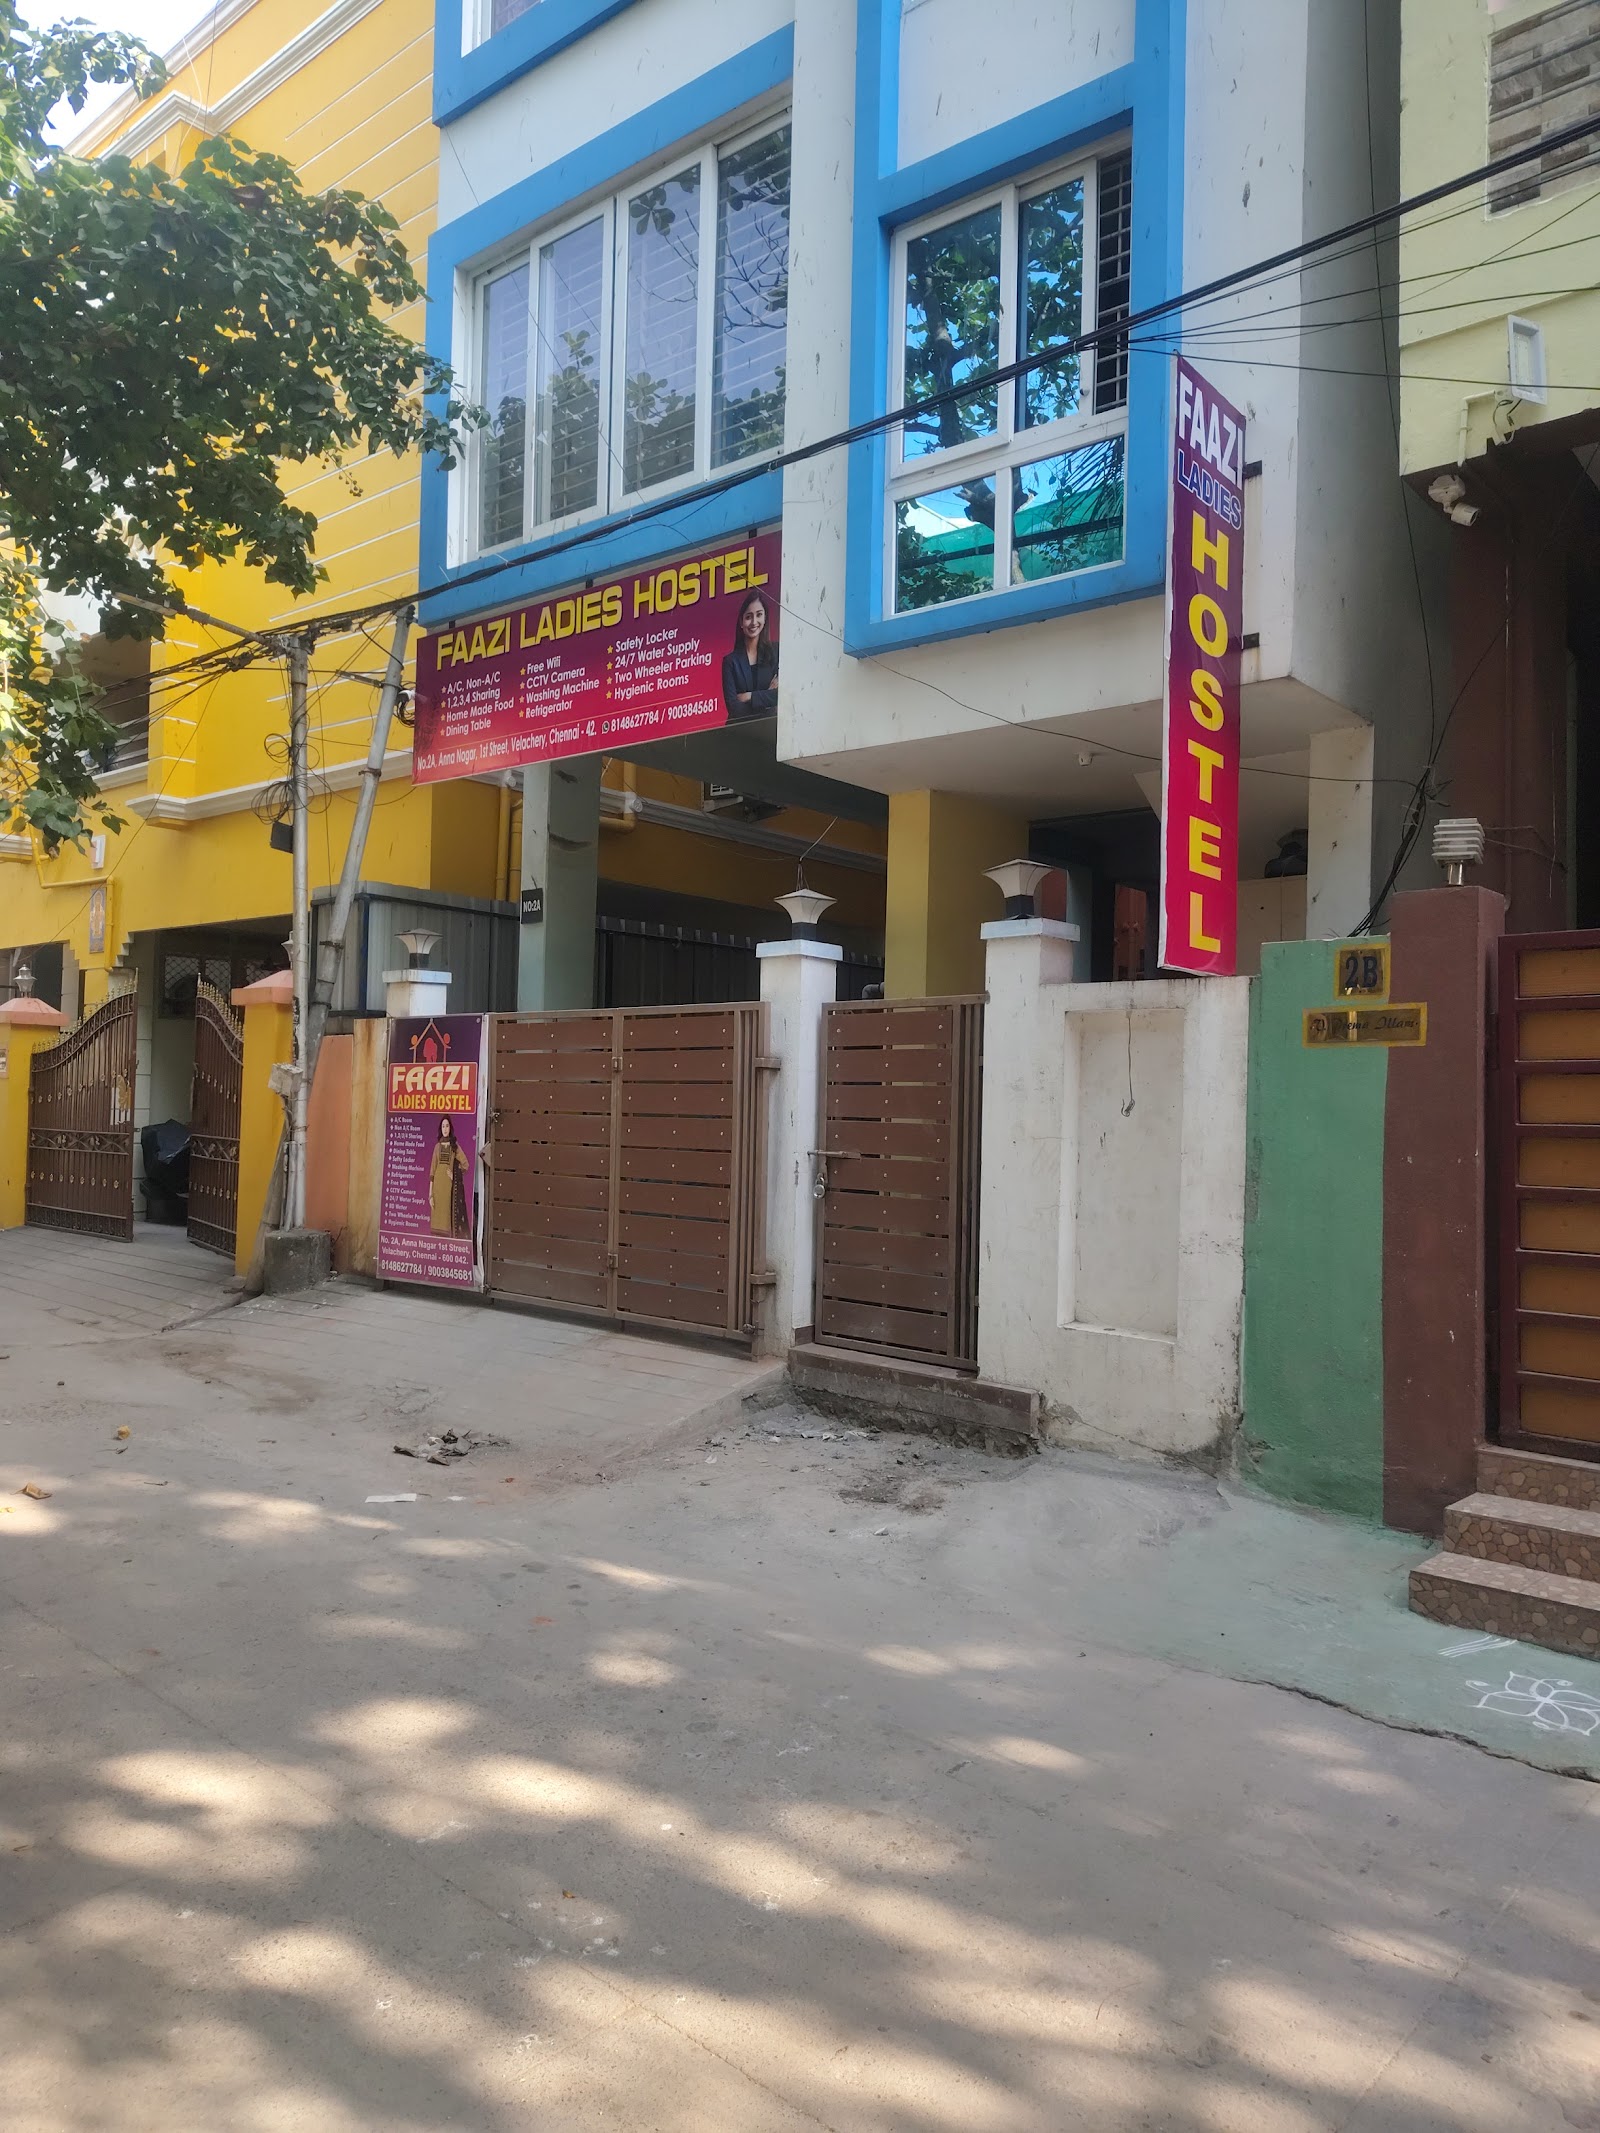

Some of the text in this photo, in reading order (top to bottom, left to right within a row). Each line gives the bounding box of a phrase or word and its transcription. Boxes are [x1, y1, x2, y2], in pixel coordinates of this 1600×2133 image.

[1178, 371, 1243, 491] FAAZI
[1177, 448, 1242, 530] LADIES
[437, 546, 769, 671] FAAZI LADIES HOSTEL
[615, 627, 679, 653] Safety Locker
[615, 638, 700, 668] 24/7 Water Supply
[526, 667, 586, 689] CCTV Camera
[527, 656, 561, 675] Free Wifi
[615, 652, 713, 684] Two Wheeler Parking
[466, 671, 501, 690] Non-A/C
[526, 679, 600, 705] Washing Machine
[614, 673, 689, 702] Hygienic Rooms
[446, 697, 514, 722] Home Made Food
[447, 688, 501, 709] 1,2,3,4 Sharing
[526, 699, 573, 719] Refrigerator
[439, 749, 455, 767] Anna
[456, 746, 477, 767] Nagar,
[480, 743, 489, 759] 1st
[489, 739, 510, 757] Street,
[511, 731, 549, 754] Velachery,
[549, 723, 580, 745] Chennai
[585, 720, 597, 737] 42.
[611, 711, 659, 732] 8148627784
[661, 708, 666, 725] /
[667, 698, 719, 720] 9003845681
[446, 718, 492, 737] Dining Table
[1187, 510, 1230, 954] HOSTEL
[1345, 956, 1378, 988] 2B
[393, 1065, 470, 1093] FAAZI
[392, 1094, 471, 1111] LADIES HOSTEL
[380, 1235, 471, 1254] No. 2A, Anna Nagar 1st Street,
[381, 1246, 411, 1259] Velachery,
[412, 1250, 437, 1261] Chennai
[442, 1253, 453, 1262] 600
[454, 1255, 469, 1265] 042.
[381, 1259, 422, 1275] 8148627784
[427, 1265, 473, 1282] 9003845681
